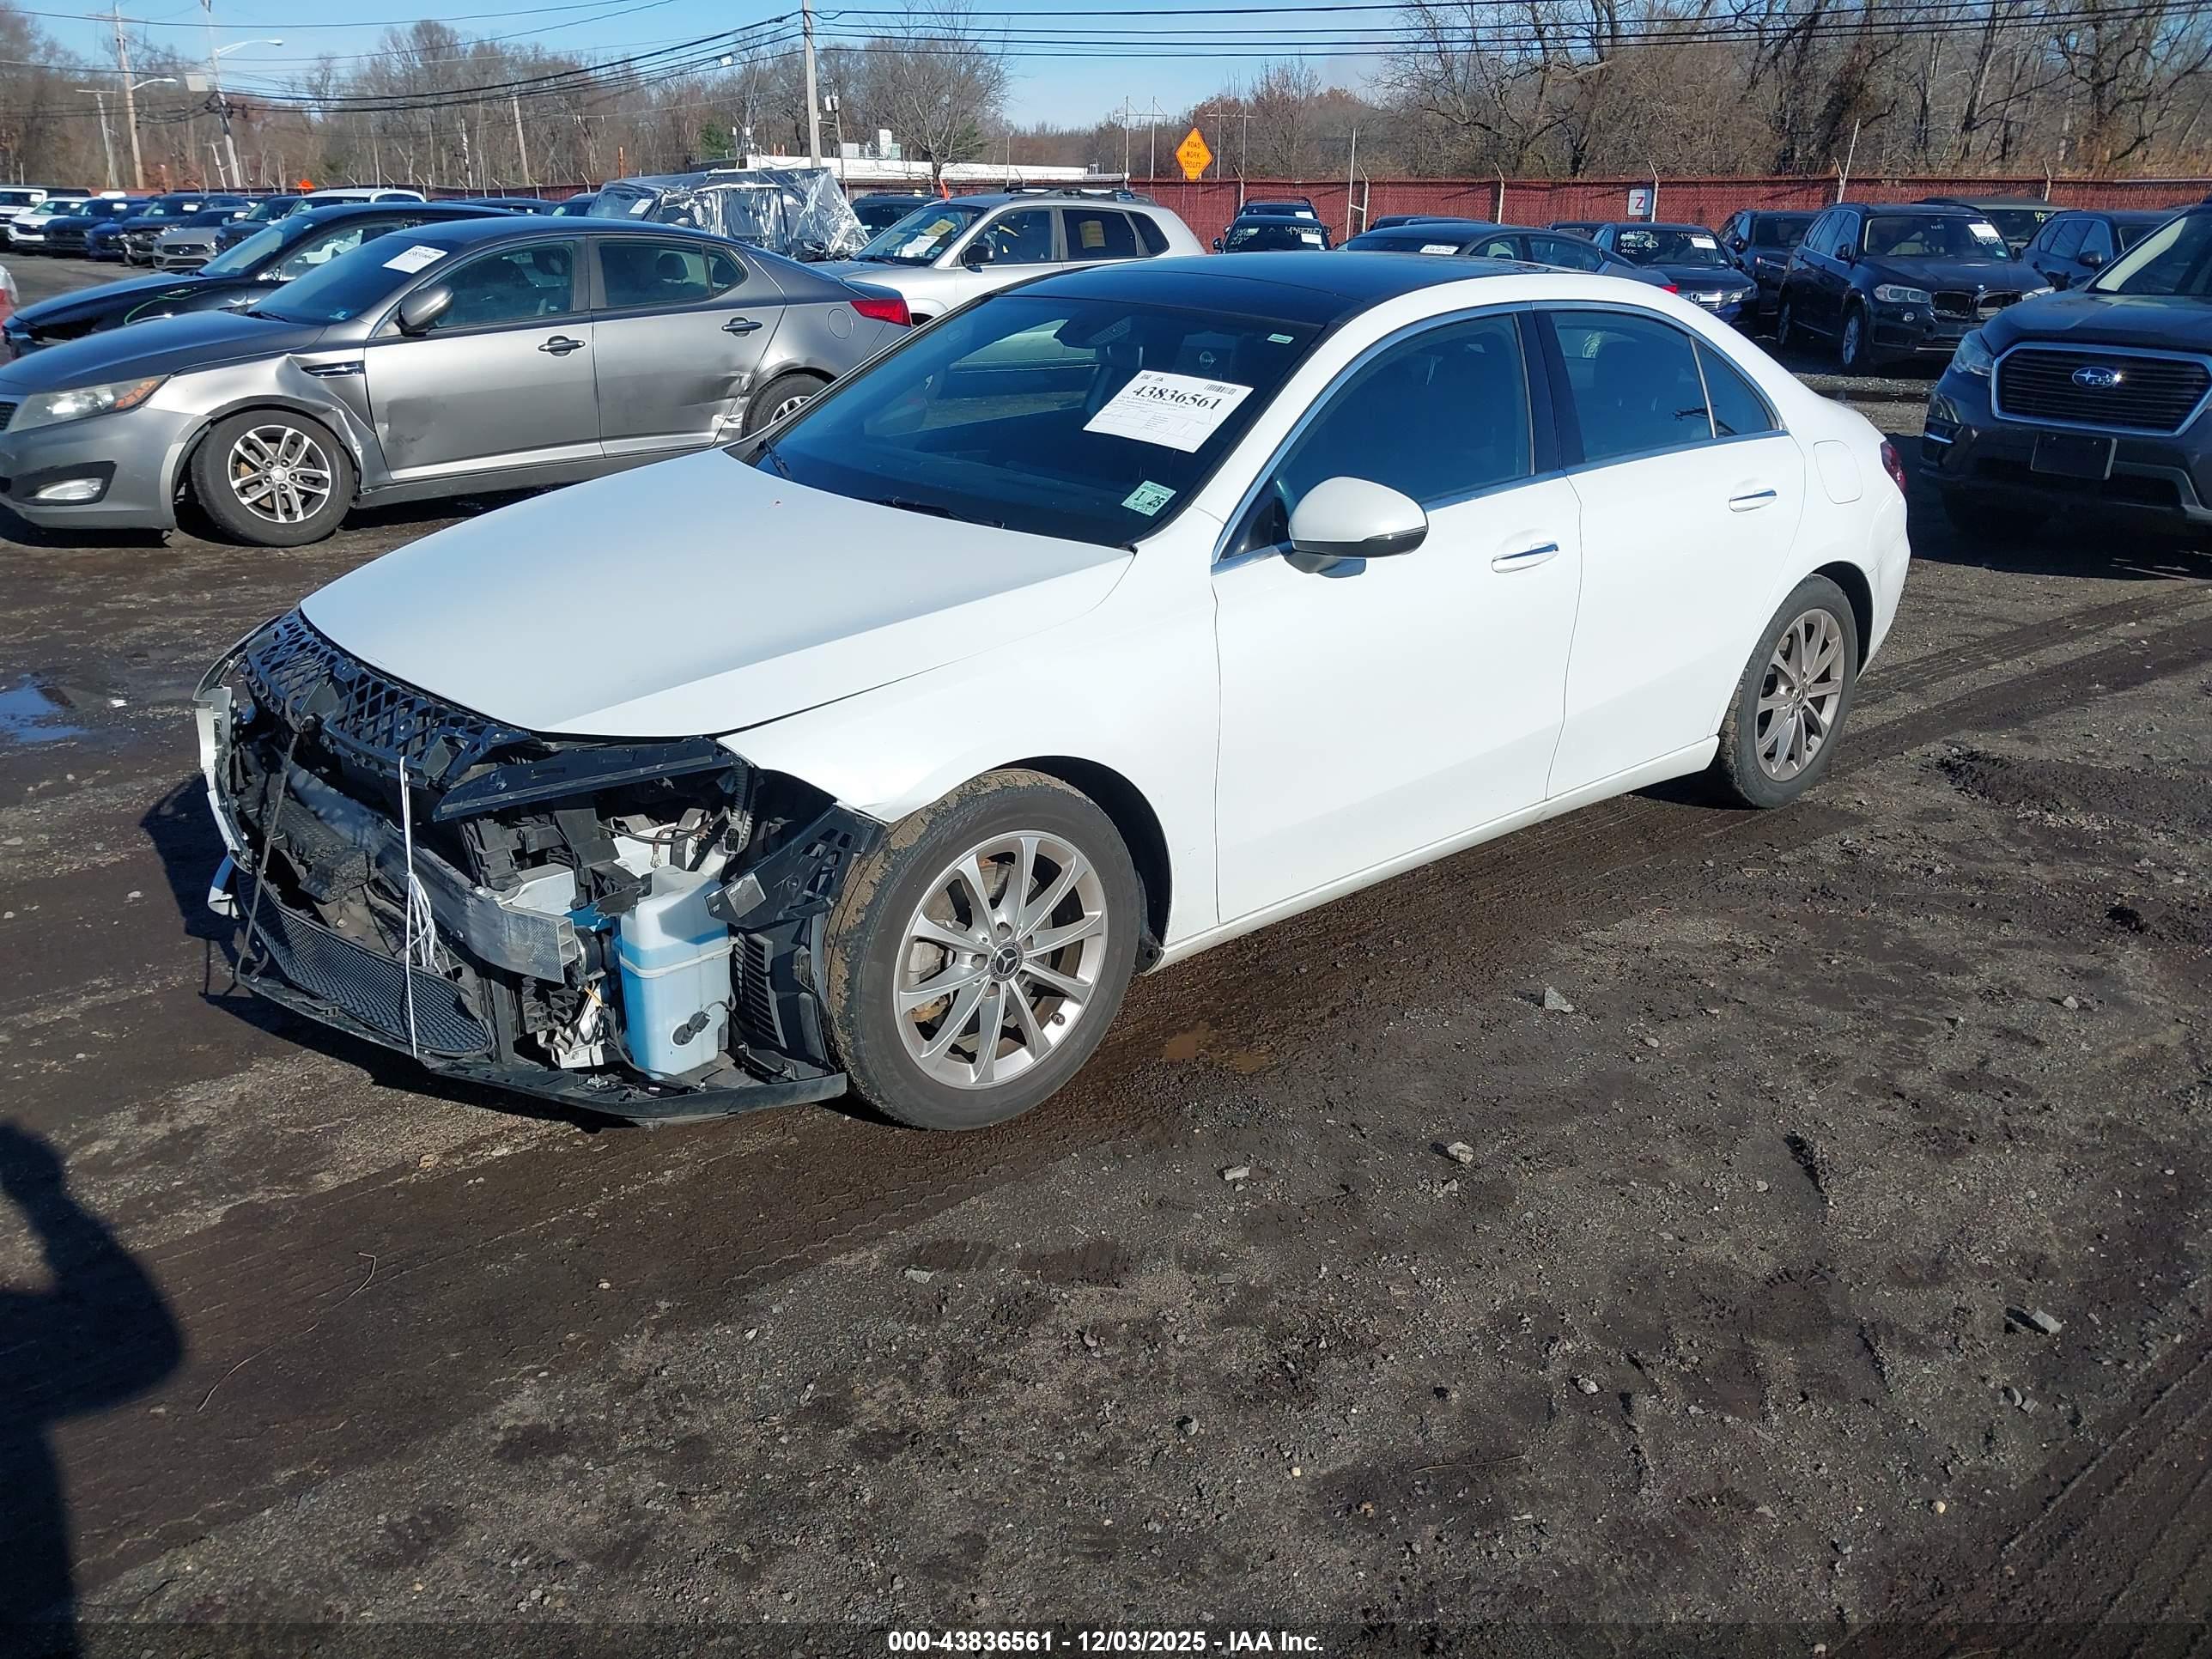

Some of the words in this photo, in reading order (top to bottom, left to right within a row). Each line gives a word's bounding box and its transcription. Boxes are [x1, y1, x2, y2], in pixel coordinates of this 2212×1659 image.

[1635, 197, 1644, 209] Z
[1133, 385, 1223, 410] 43836561
[1134, 490, 1146, 501] 1
[1146, 495, 1166, 507] 25
